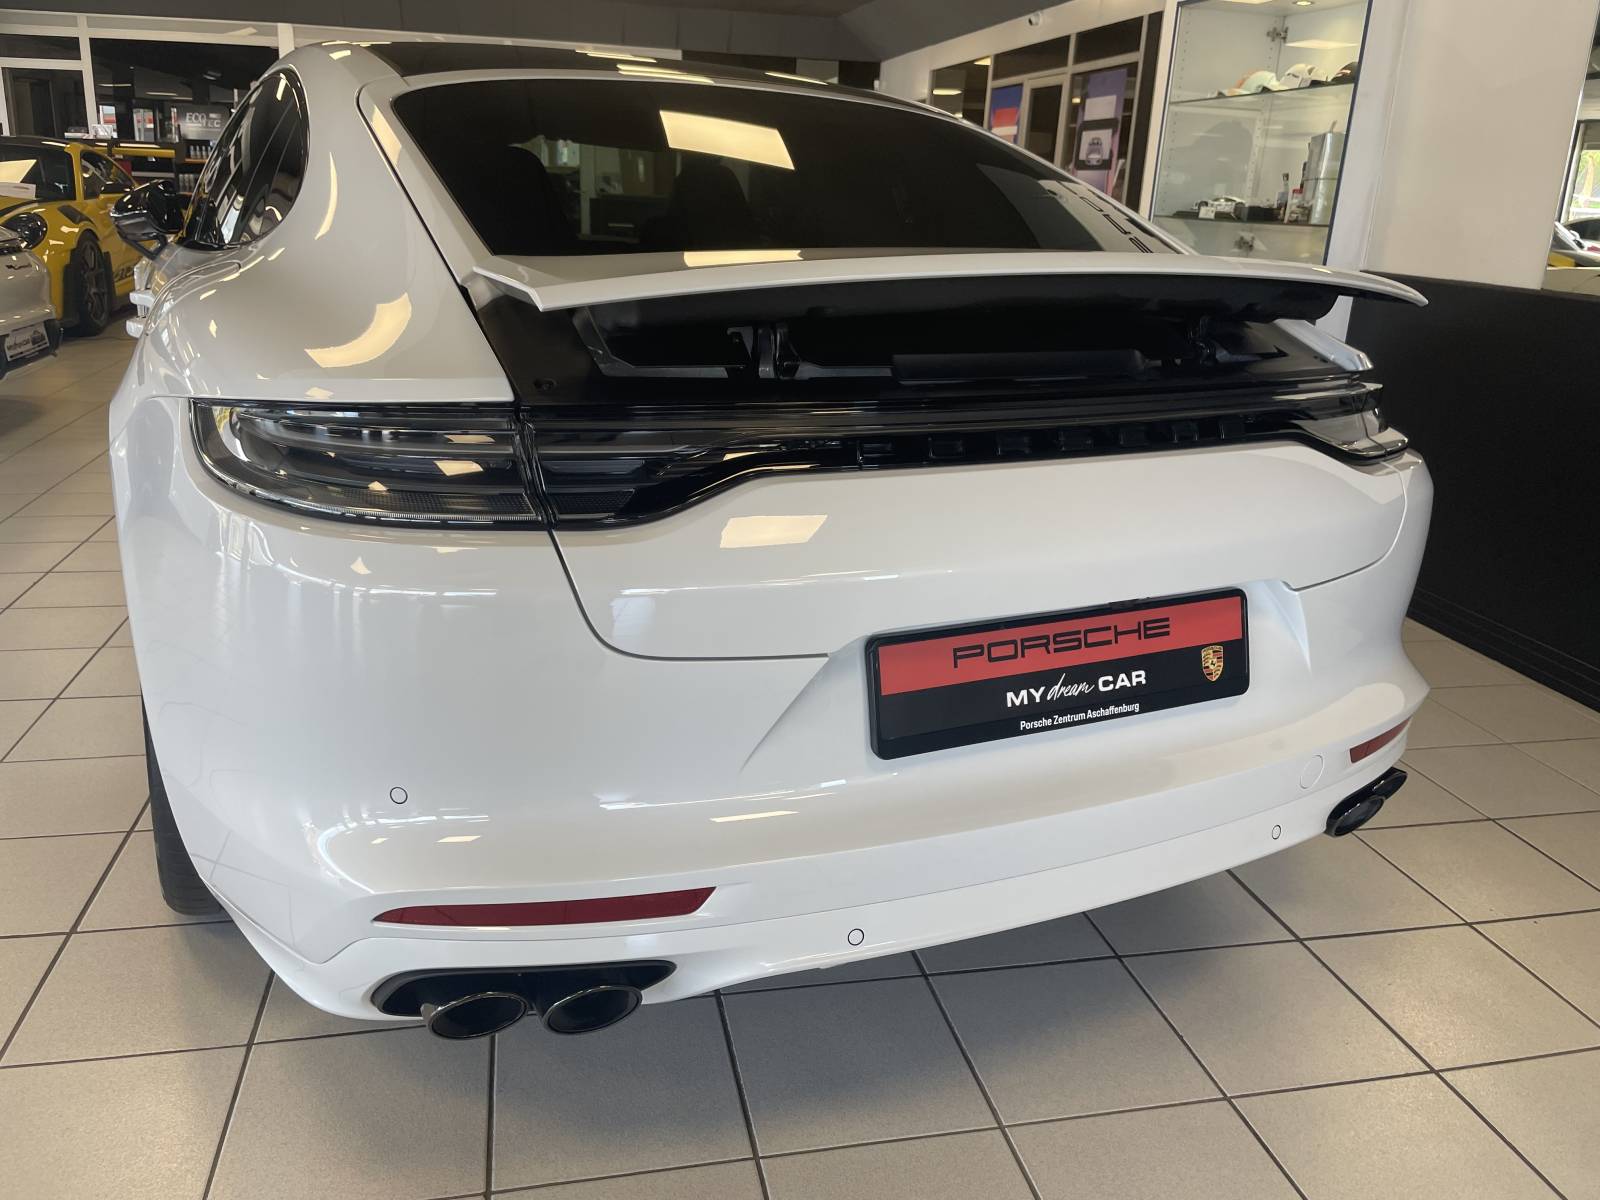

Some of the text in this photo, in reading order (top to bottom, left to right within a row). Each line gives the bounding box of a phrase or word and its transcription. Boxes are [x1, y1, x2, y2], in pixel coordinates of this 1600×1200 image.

[953, 617, 1170, 668] PORSCHE
[1006, 669, 1147, 707] MY dream CAR
[1020, 703, 1140, 731] Porsche Zentrum Aschaffenburg
